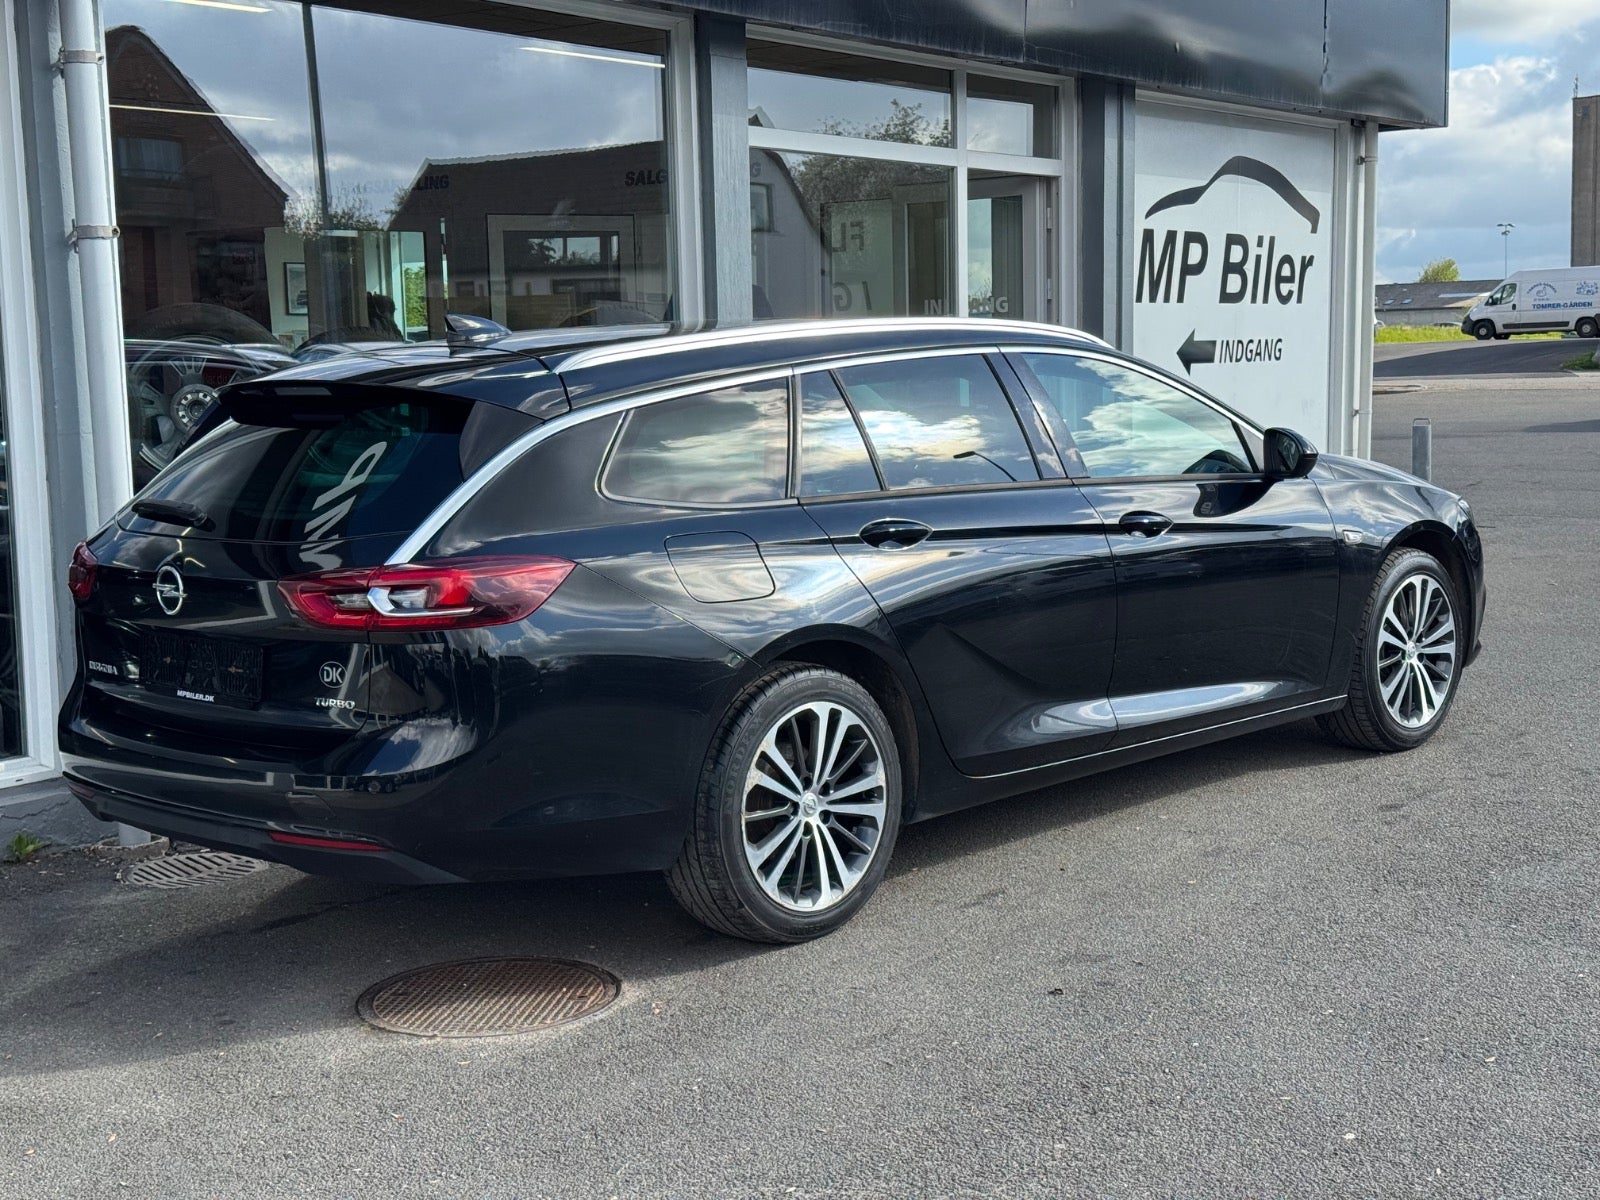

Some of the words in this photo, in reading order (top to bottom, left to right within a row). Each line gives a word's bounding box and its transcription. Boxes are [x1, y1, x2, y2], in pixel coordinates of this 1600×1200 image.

[1135, 228, 1209, 303] MP
[1219, 233, 1314, 305] Biler
[1219, 338, 1283, 363] INDGANG
[323, 666, 343, 684] DK
[176, 690, 215, 702] MPBILER.DK
[314, 697, 356, 710] TURBO
